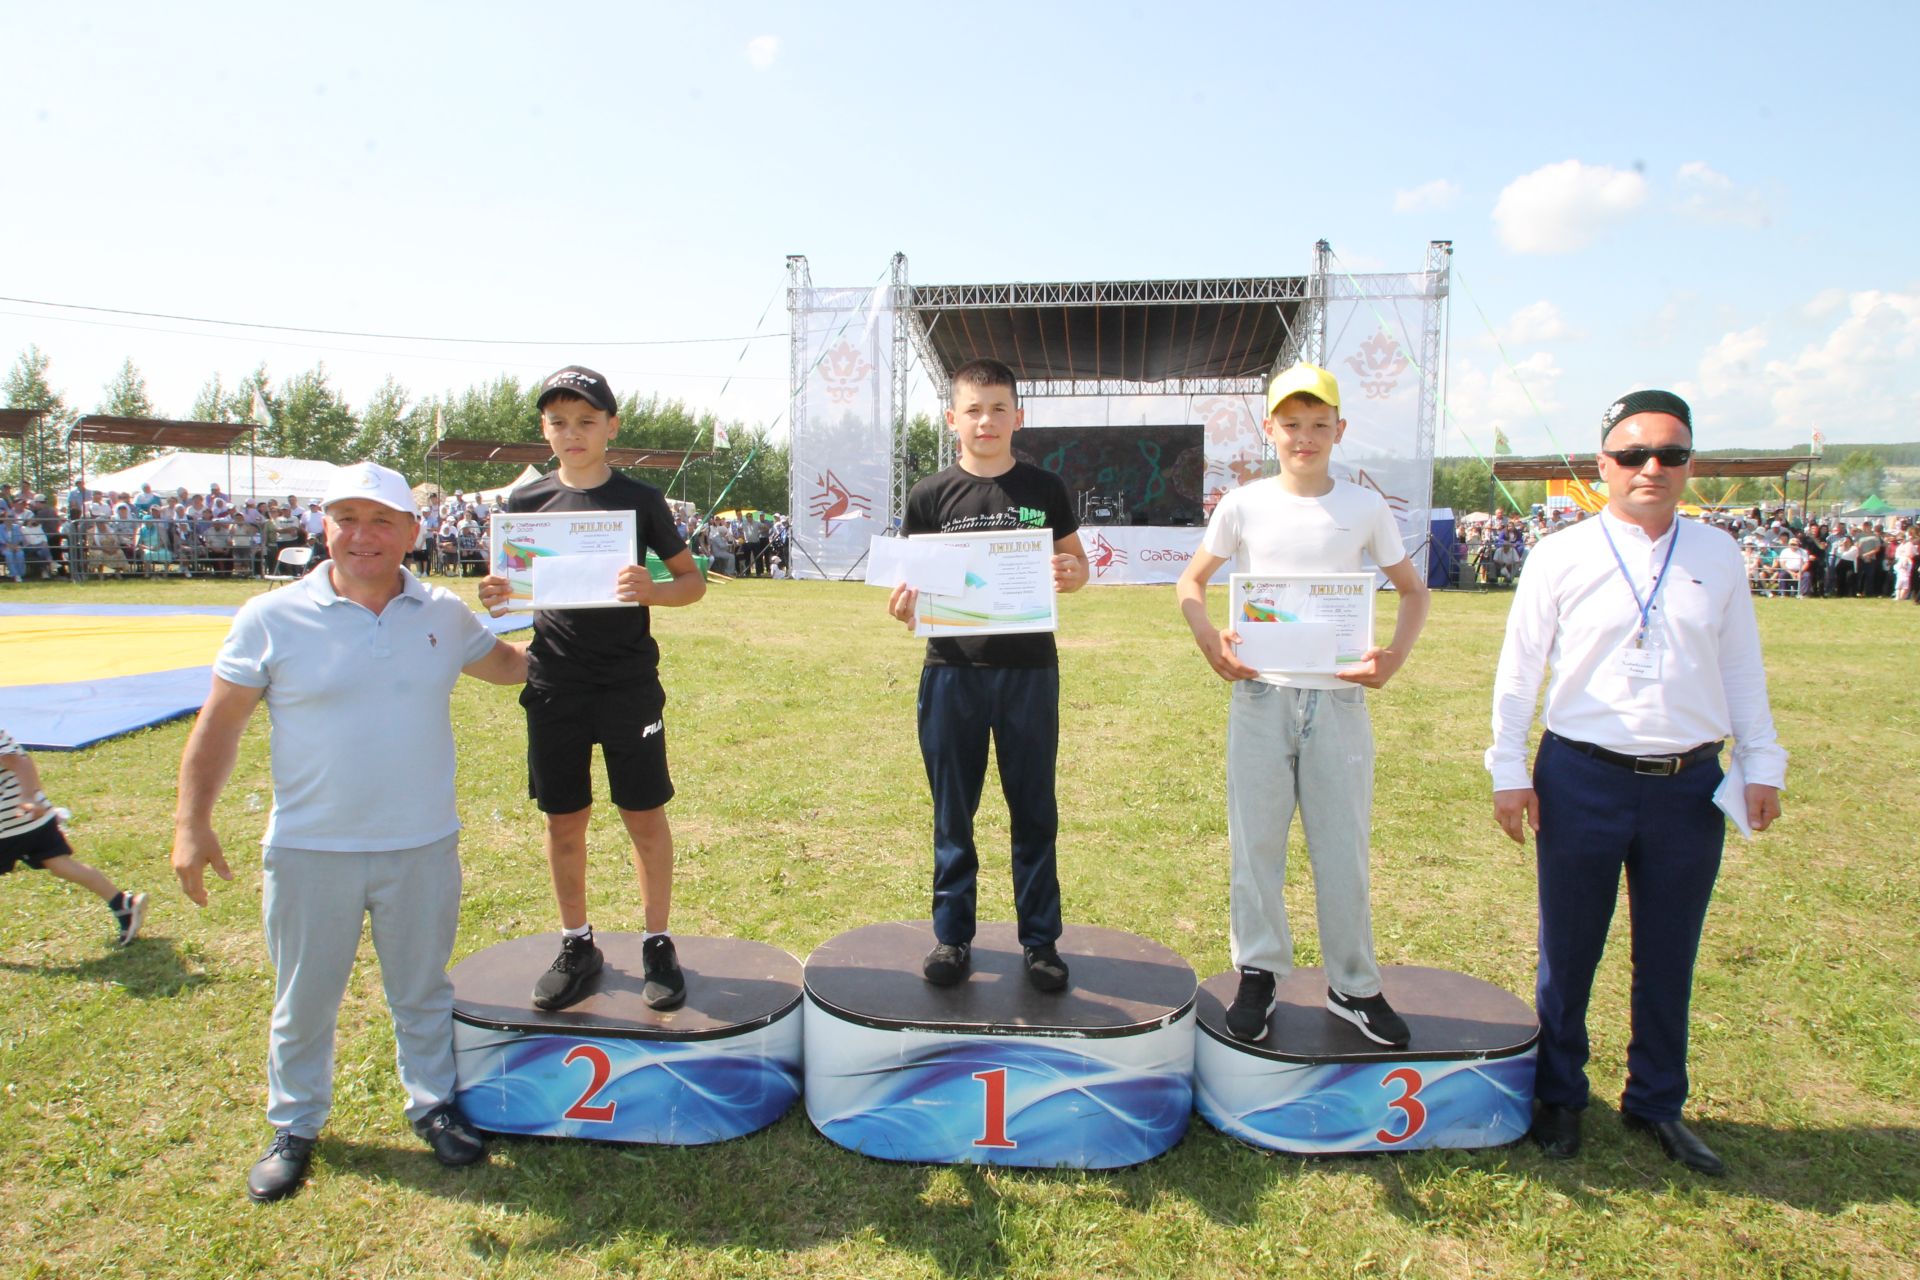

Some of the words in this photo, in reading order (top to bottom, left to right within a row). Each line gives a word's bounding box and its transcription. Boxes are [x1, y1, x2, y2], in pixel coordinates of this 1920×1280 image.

[569, 521, 624, 535] ДИПЛОМ
[989, 540, 1042, 556] ДИПЛОМ
[1140, 549, 1195, 561] Сабан
[1309, 584, 1365, 598] ДИПЛОМ
[562, 1044, 617, 1124] 2
[972, 1067, 1018, 1149] 1
[1376, 1068, 1428, 1145] 3
